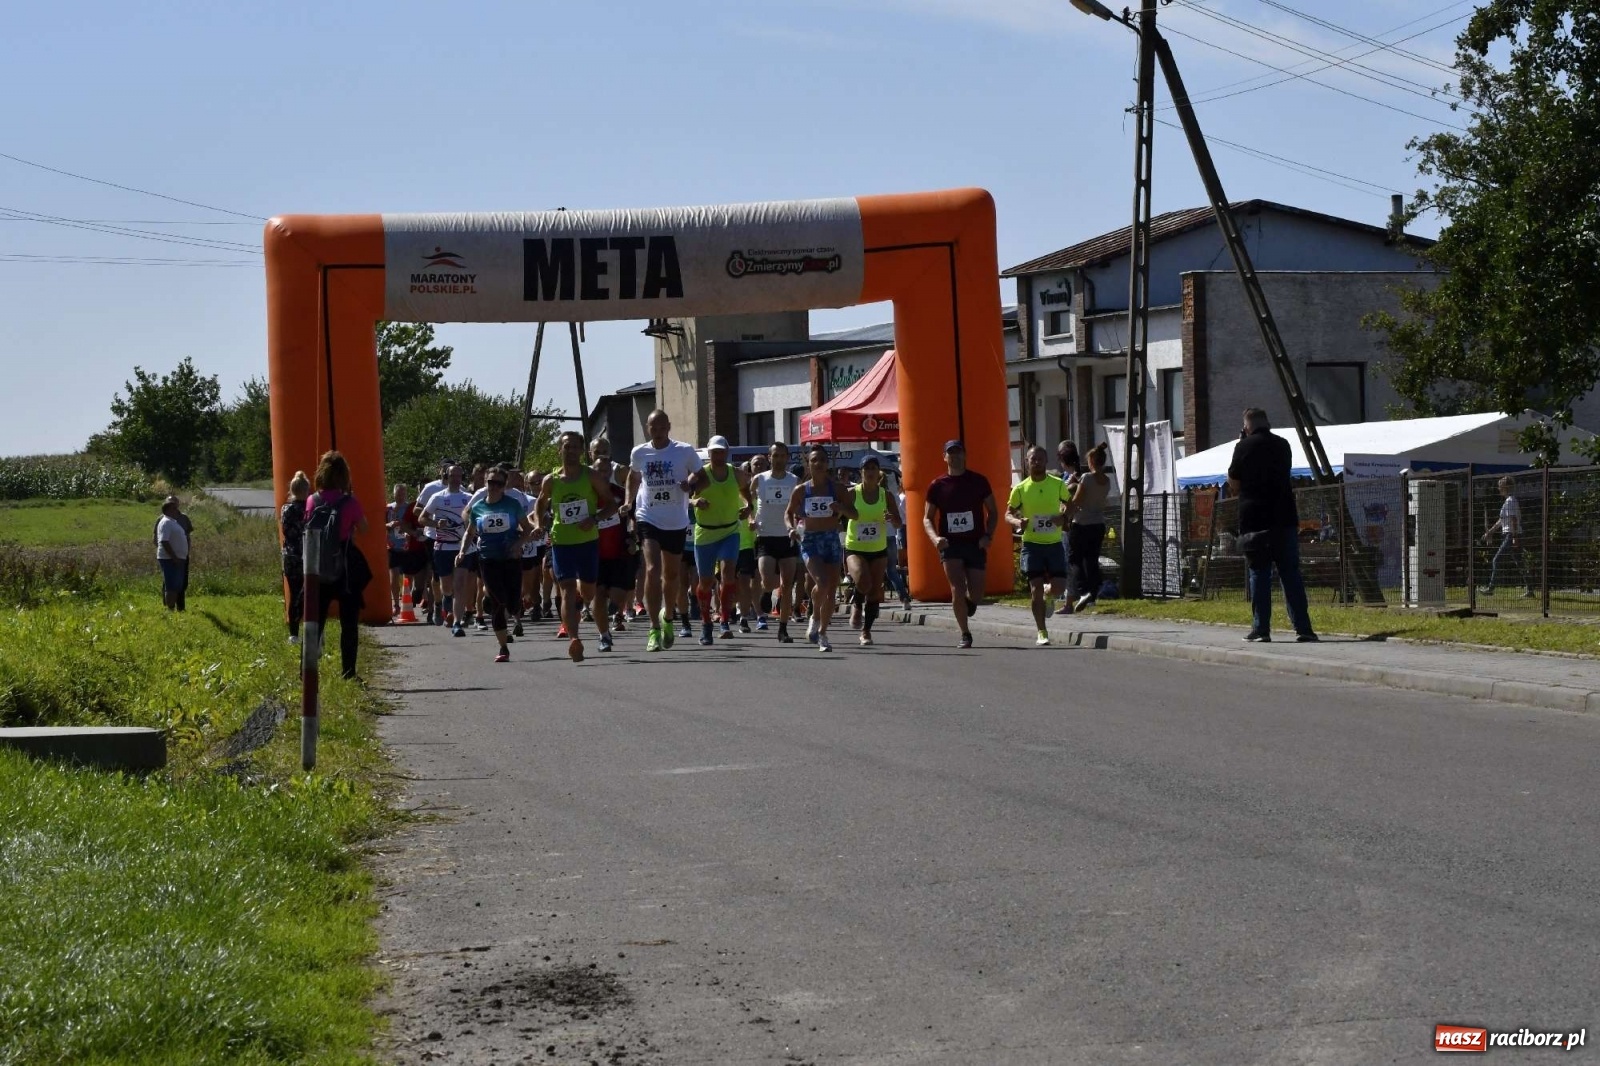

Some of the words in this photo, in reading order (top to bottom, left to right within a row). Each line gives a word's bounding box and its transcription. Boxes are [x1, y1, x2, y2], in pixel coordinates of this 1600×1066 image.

[523, 236, 684, 301] META
[410, 273, 477, 284] MARATONY
[410, 284, 477, 294] POLSKIE.PL
[654, 491, 671, 501] 48
[774, 490, 782, 499] 6
[565, 506, 581, 517] 67
[811, 501, 828, 512] 36
[488, 518, 503, 528] 28
[952, 517, 968, 526] 44
[1037, 519, 1052, 528] 56
[862, 527, 877, 536] 43
